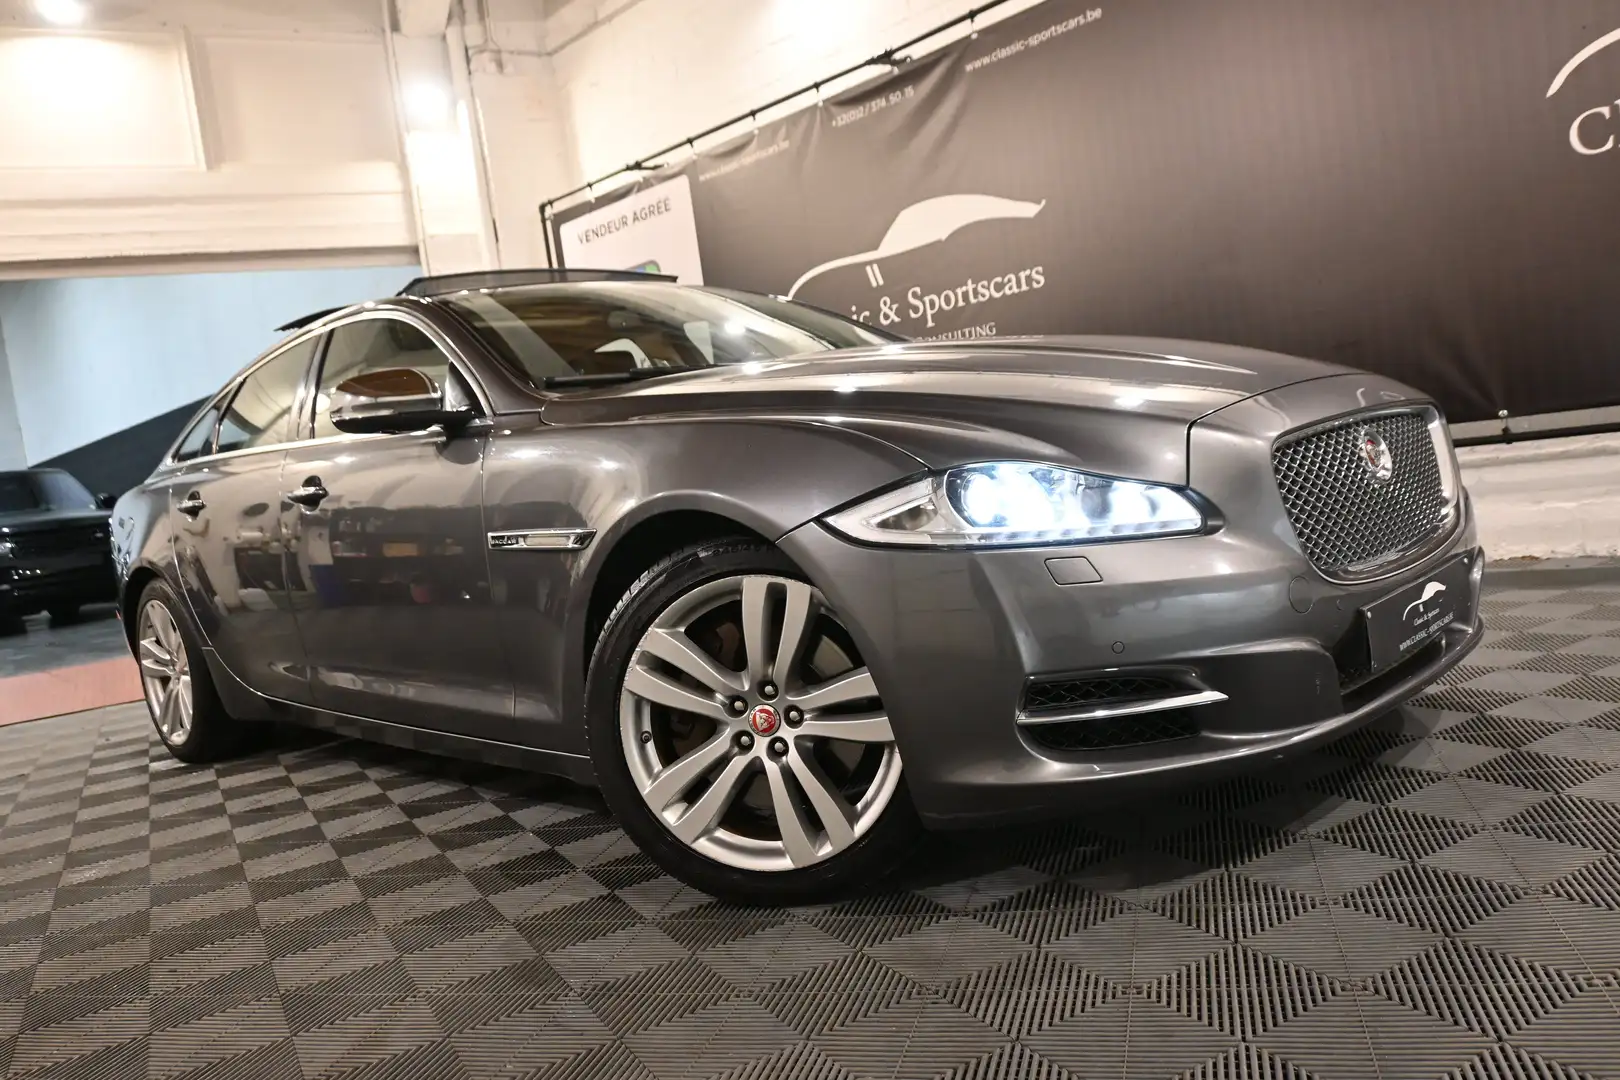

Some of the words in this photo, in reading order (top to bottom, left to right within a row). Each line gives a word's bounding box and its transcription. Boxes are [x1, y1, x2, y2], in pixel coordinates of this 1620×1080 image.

[965, 8, 1102, 72] www.classic-sportscars.be
[577, 215, 629, 244] VENDEUR
[880, 296, 901, 326] &
[907, 265, 1046, 327] Sportscars
